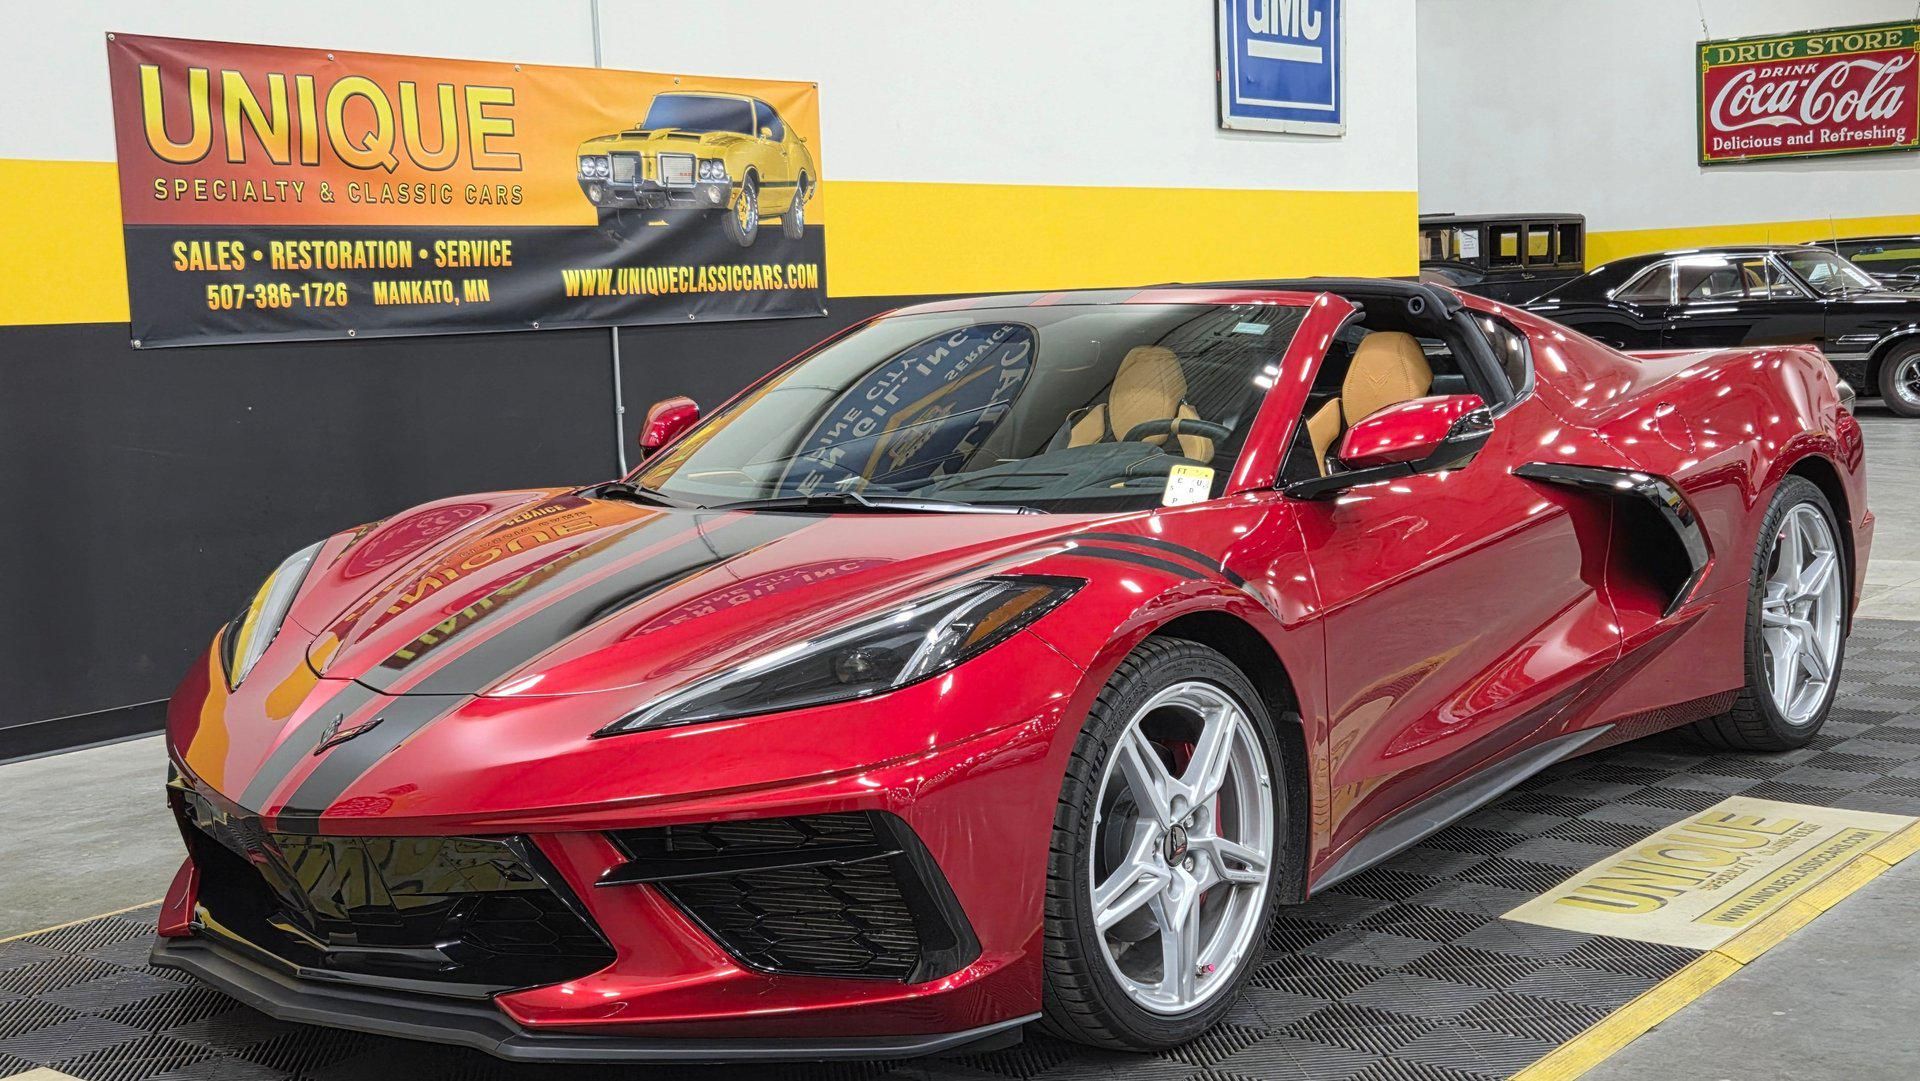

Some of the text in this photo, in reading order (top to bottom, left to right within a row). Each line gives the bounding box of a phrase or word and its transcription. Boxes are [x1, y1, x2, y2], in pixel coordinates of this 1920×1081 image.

[1718, 31, 1903, 64] DRUG STORE
[1758, 63, 1820, 79] DRINK
[1710, 54, 1917, 132] Coca-Cola
[138, 63, 523, 174] UNIQUE
[1713, 125, 1906, 151] Delicious and Refreshing
[153, 178, 524, 206] SPECIALTY & CLASSIC CARS
[172, 239, 513, 272] SALES RESTORATION SERVICE
[206, 278, 491, 311] 507-386-1726 MANKATO, MN
[561, 263, 819, 297] WWW.UNIQUECLASSICCARS.COM
[1554, 810, 1803, 915] UNIQUE
[1713, 830, 1872, 923] WWW.UNIQUECLASSICCARS.COM
